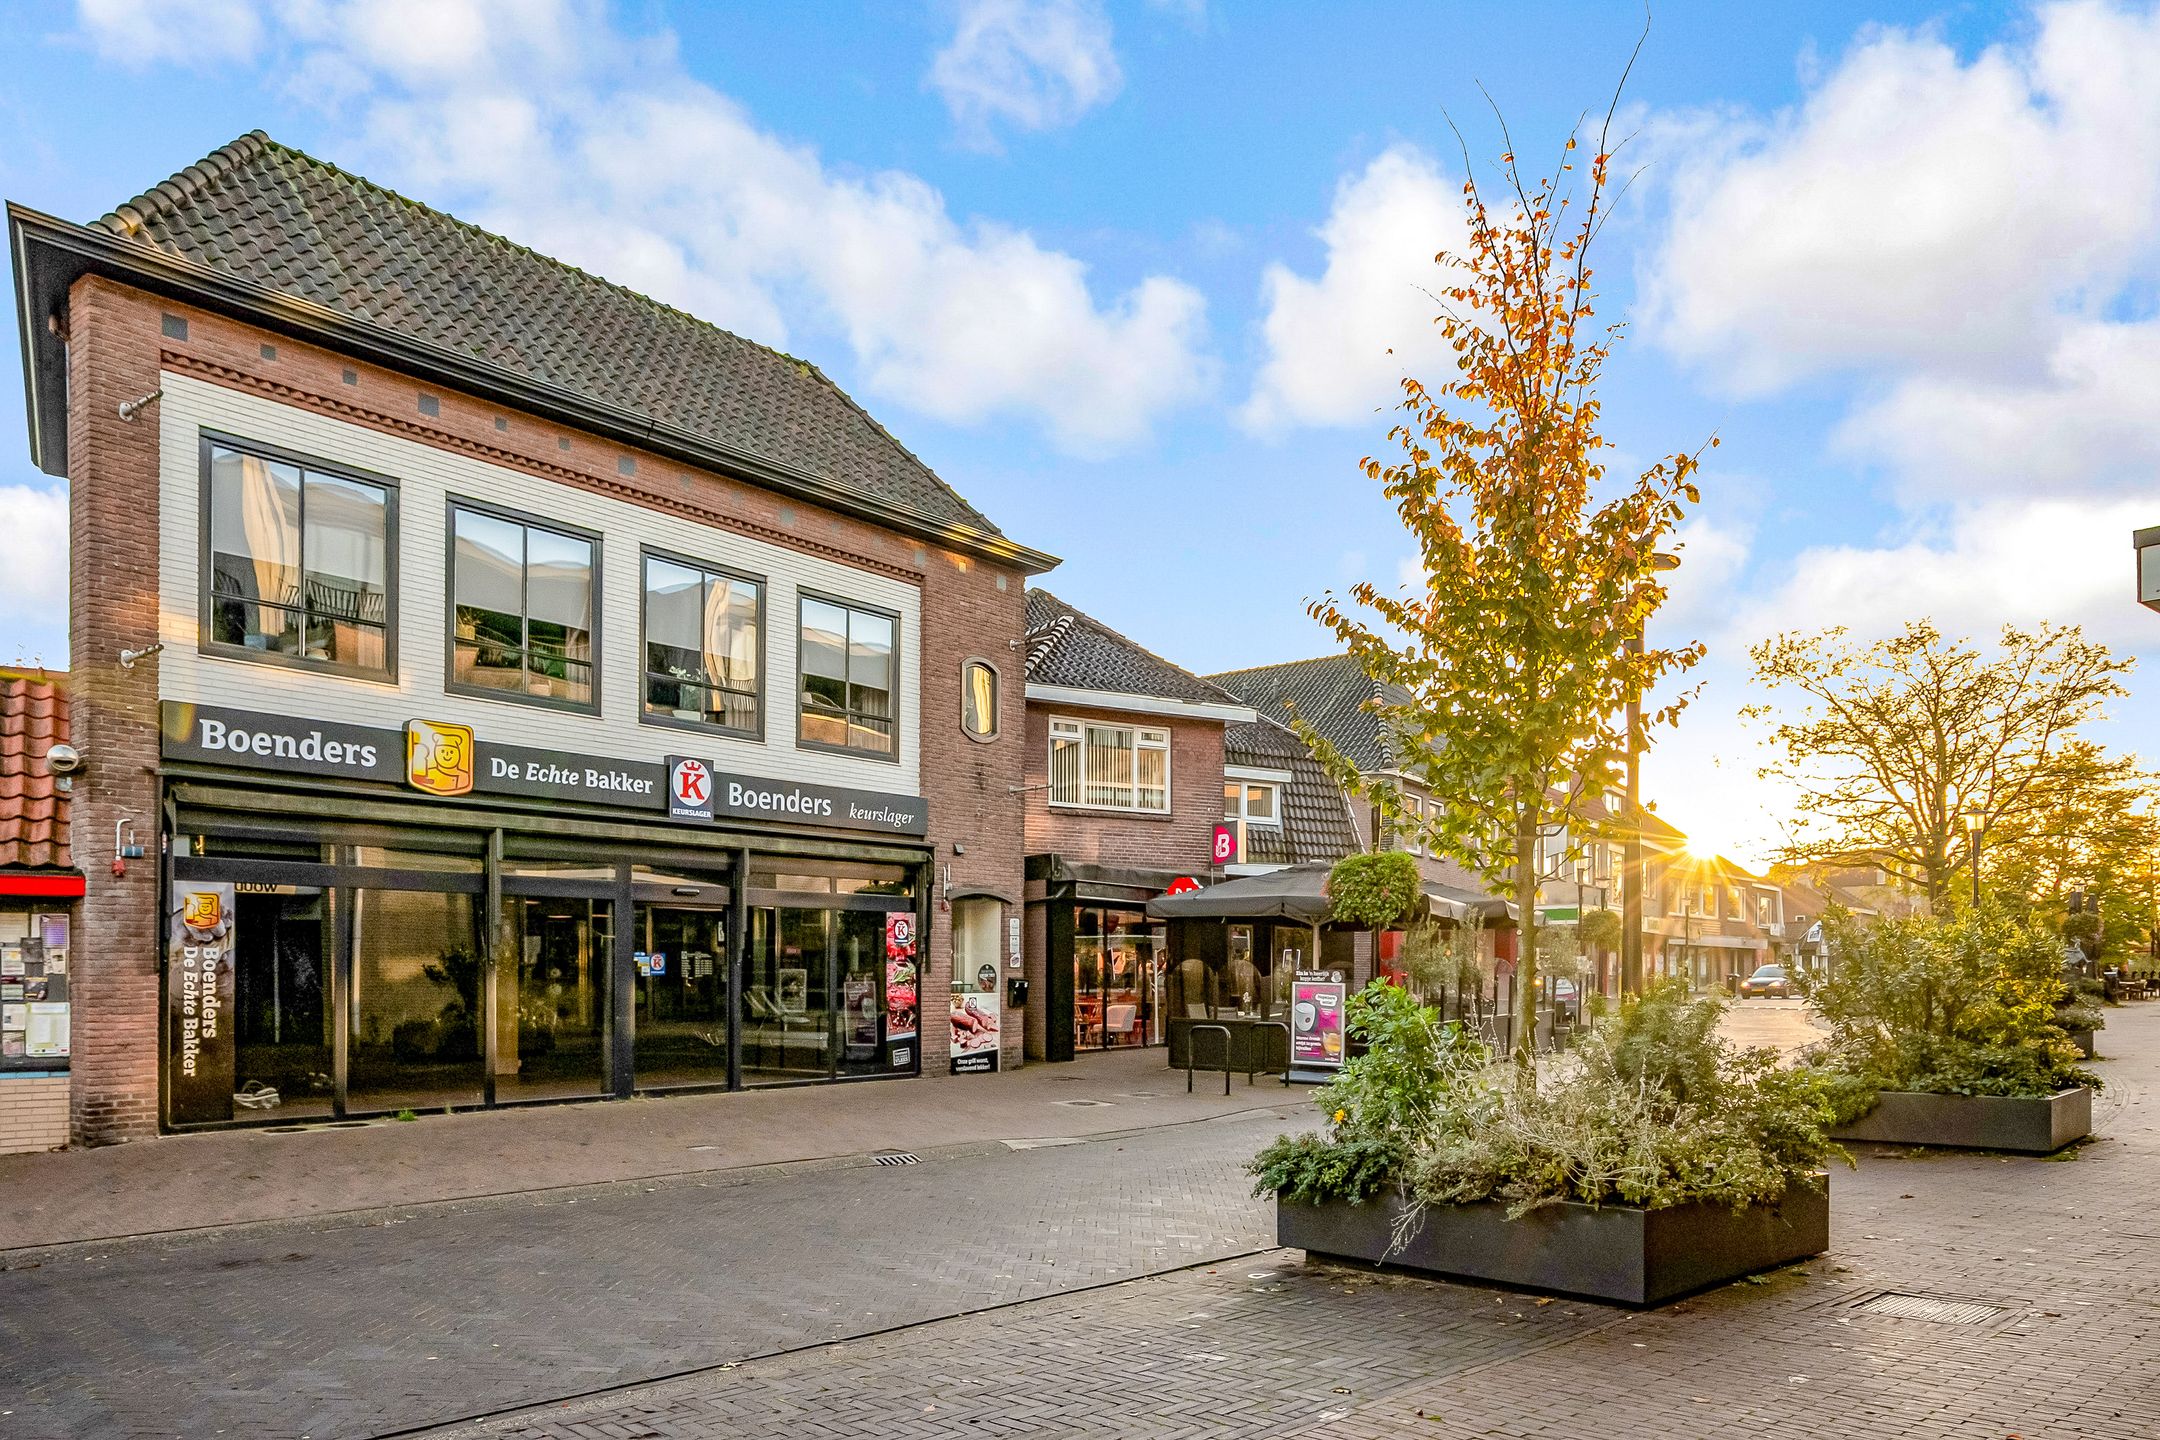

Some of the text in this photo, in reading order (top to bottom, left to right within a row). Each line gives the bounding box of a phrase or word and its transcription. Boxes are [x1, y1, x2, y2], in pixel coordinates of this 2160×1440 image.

[199, 718, 377, 768] Boenders
[490, 757, 654, 794] De Echte Bakker
[679, 771, 705, 801] K
[672, 807, 712, 818] KEURSLAGER
[729, 782, 915, 828] Boenders keurslager
[183, 946, 200, 1077] De Echte Bakker
[202, 946, 221, 1039] Boenders
